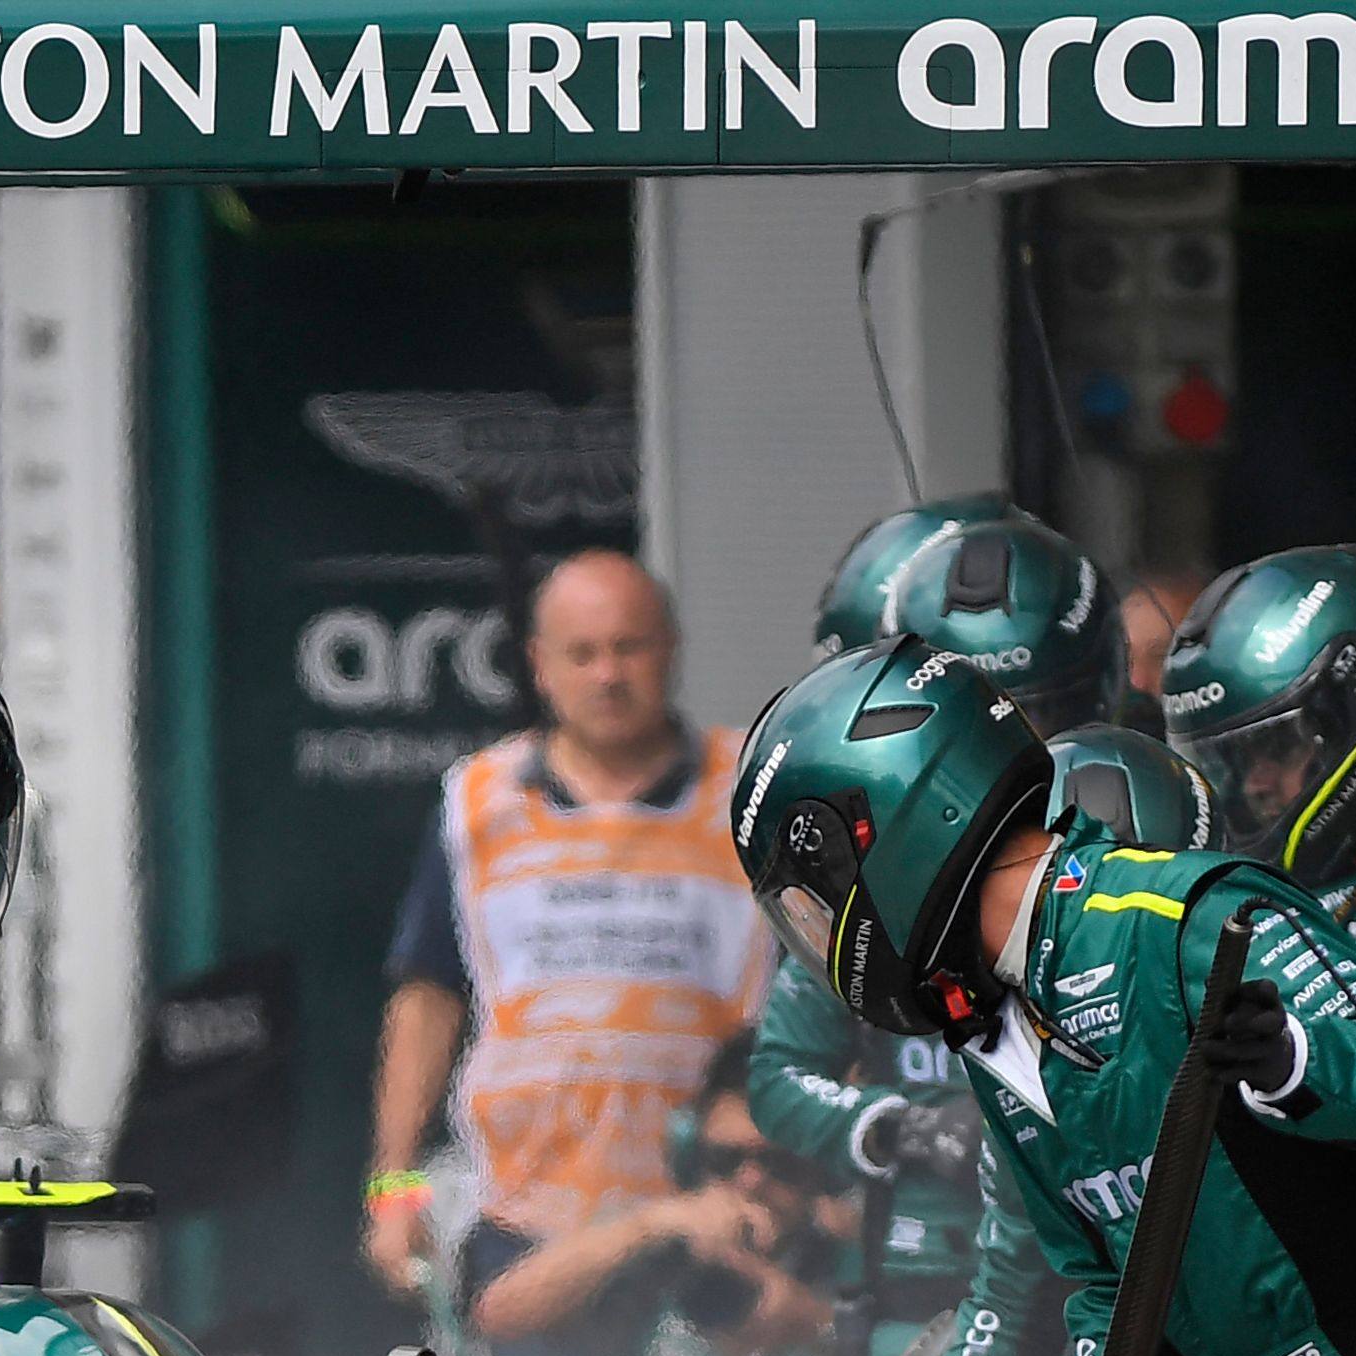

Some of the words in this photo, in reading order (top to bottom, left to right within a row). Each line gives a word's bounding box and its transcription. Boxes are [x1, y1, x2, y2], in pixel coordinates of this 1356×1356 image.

[270, 19, 816, 137] MARTIN
[854, 918, 873, 972] MARTIN
[1060, 1001, 1120, 1035] aramco
